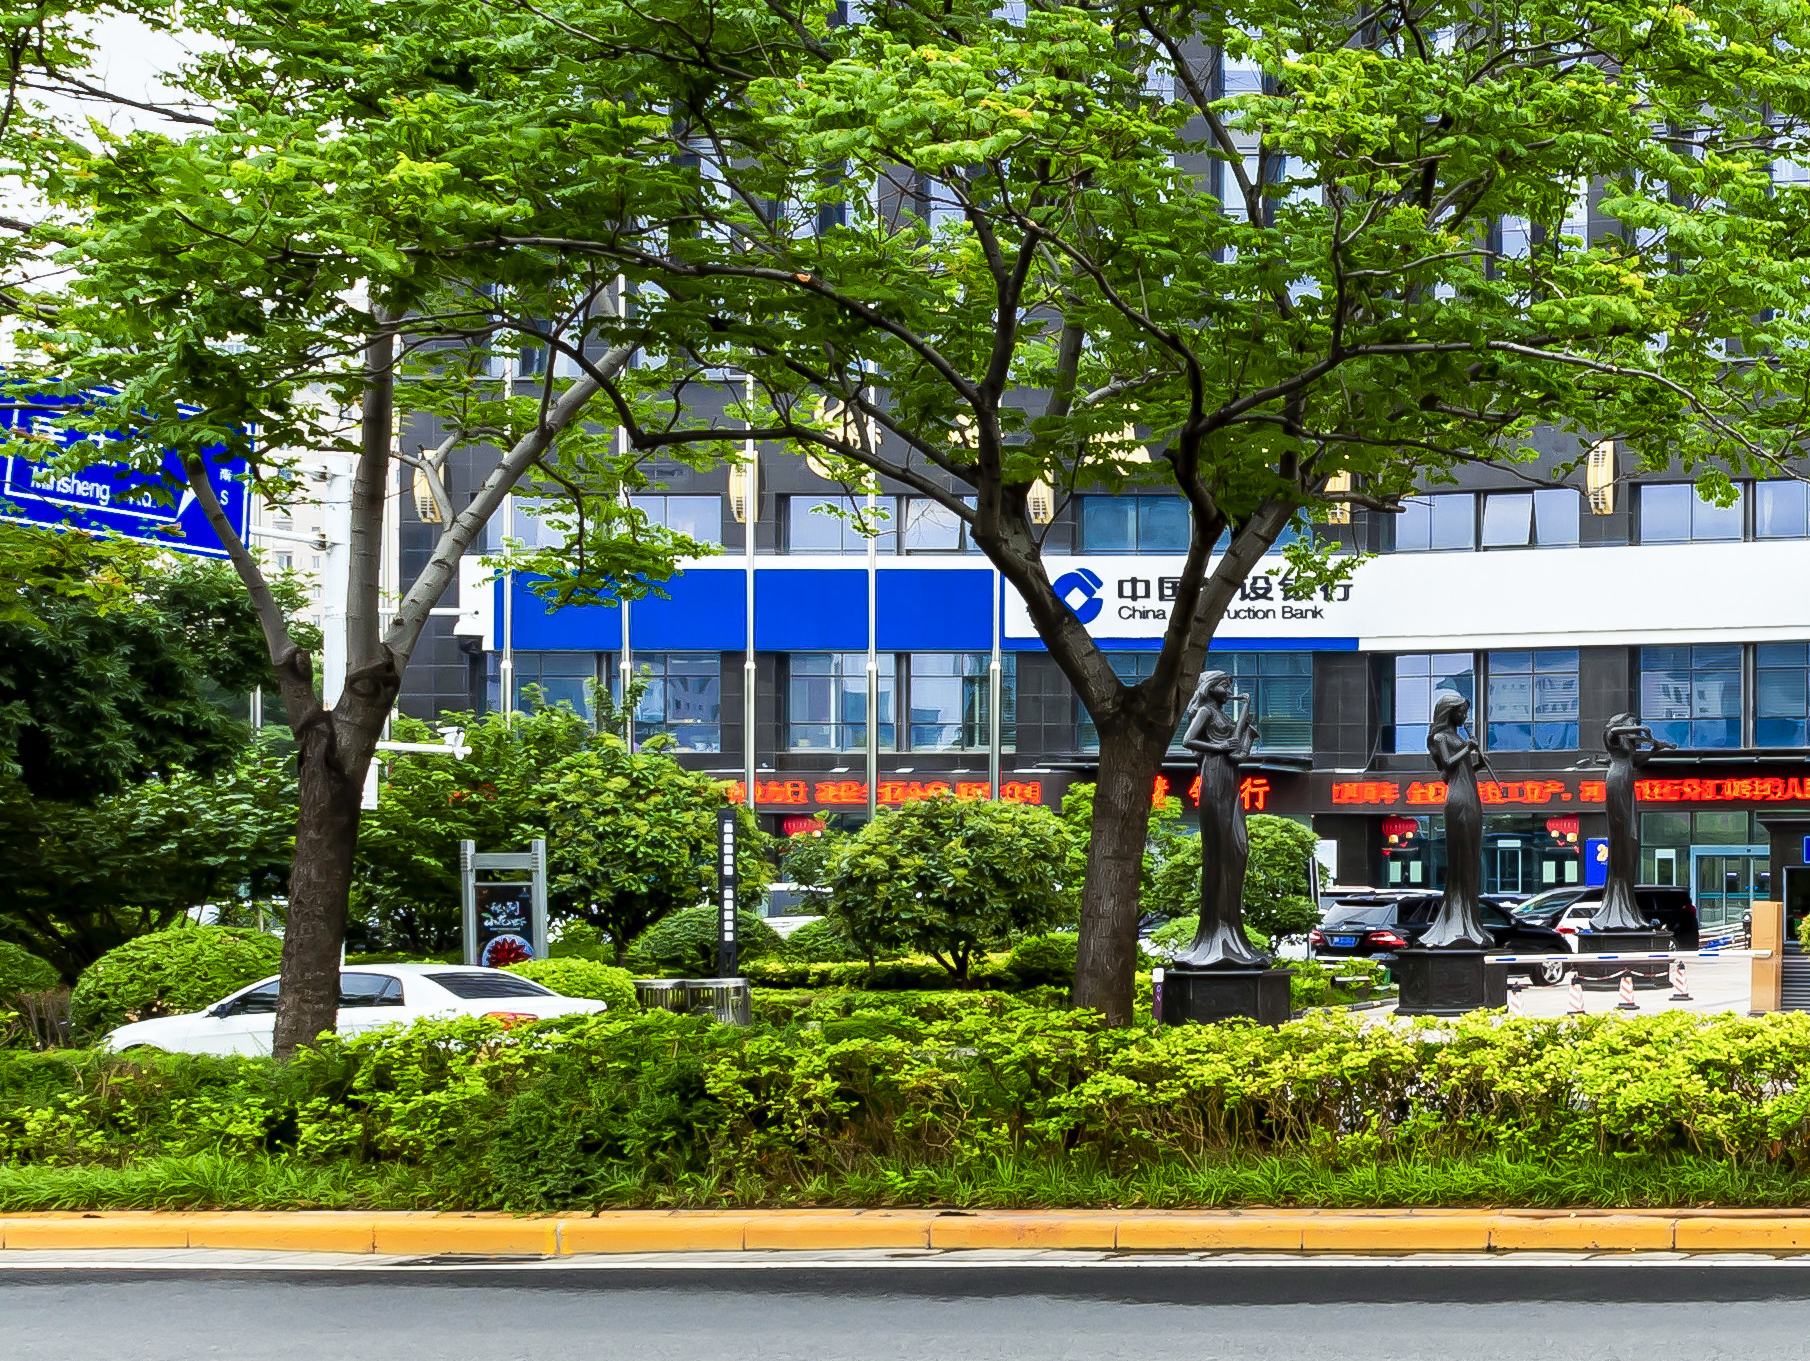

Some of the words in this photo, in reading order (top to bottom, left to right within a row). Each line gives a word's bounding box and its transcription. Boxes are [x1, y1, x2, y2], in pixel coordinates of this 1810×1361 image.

[219, 489, 229, 506] S
[1117, 576, 1354, 602] 中国设银行
[1117, 605, 1167, 620] China
[1281, 605, 1325, 620] Bank
